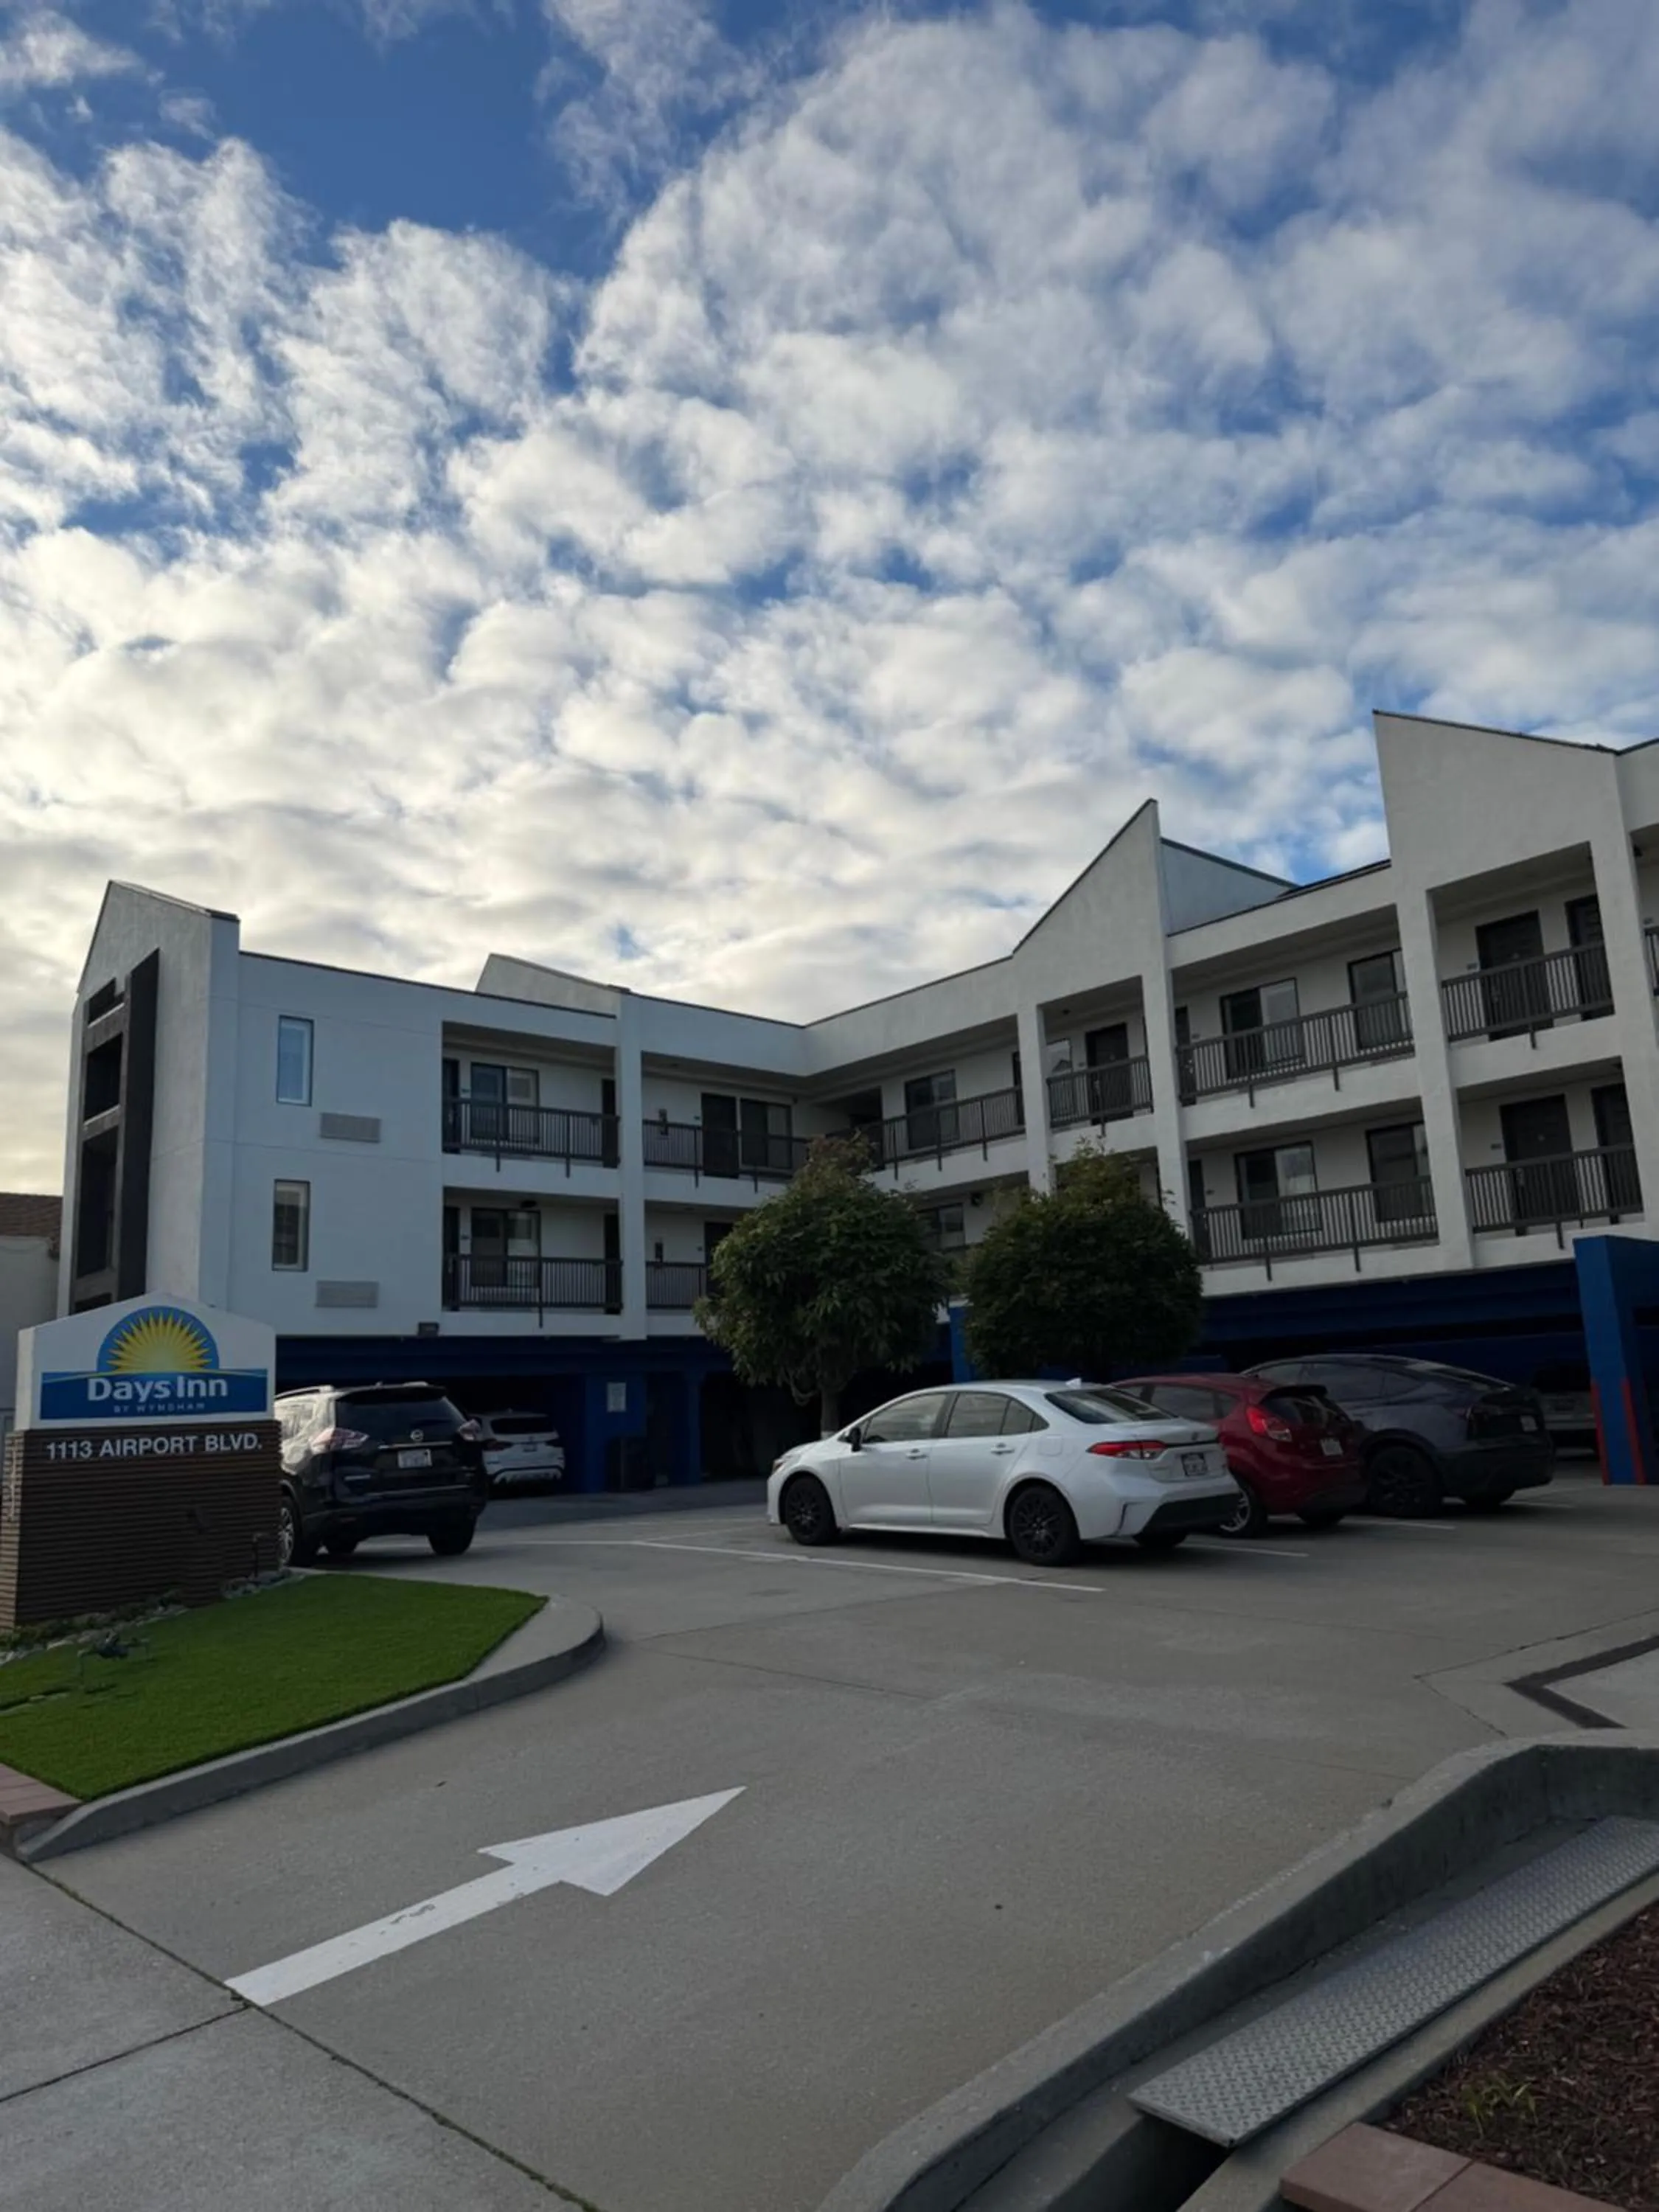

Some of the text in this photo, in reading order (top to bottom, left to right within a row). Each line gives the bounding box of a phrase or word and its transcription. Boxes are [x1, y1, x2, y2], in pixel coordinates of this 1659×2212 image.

[87, 1375, 228, 1402] Days Inn
[114, 1405, 129, 1413] BY
[46, 1433, 263, 1460] 1113 AIRPORT BLVD.
